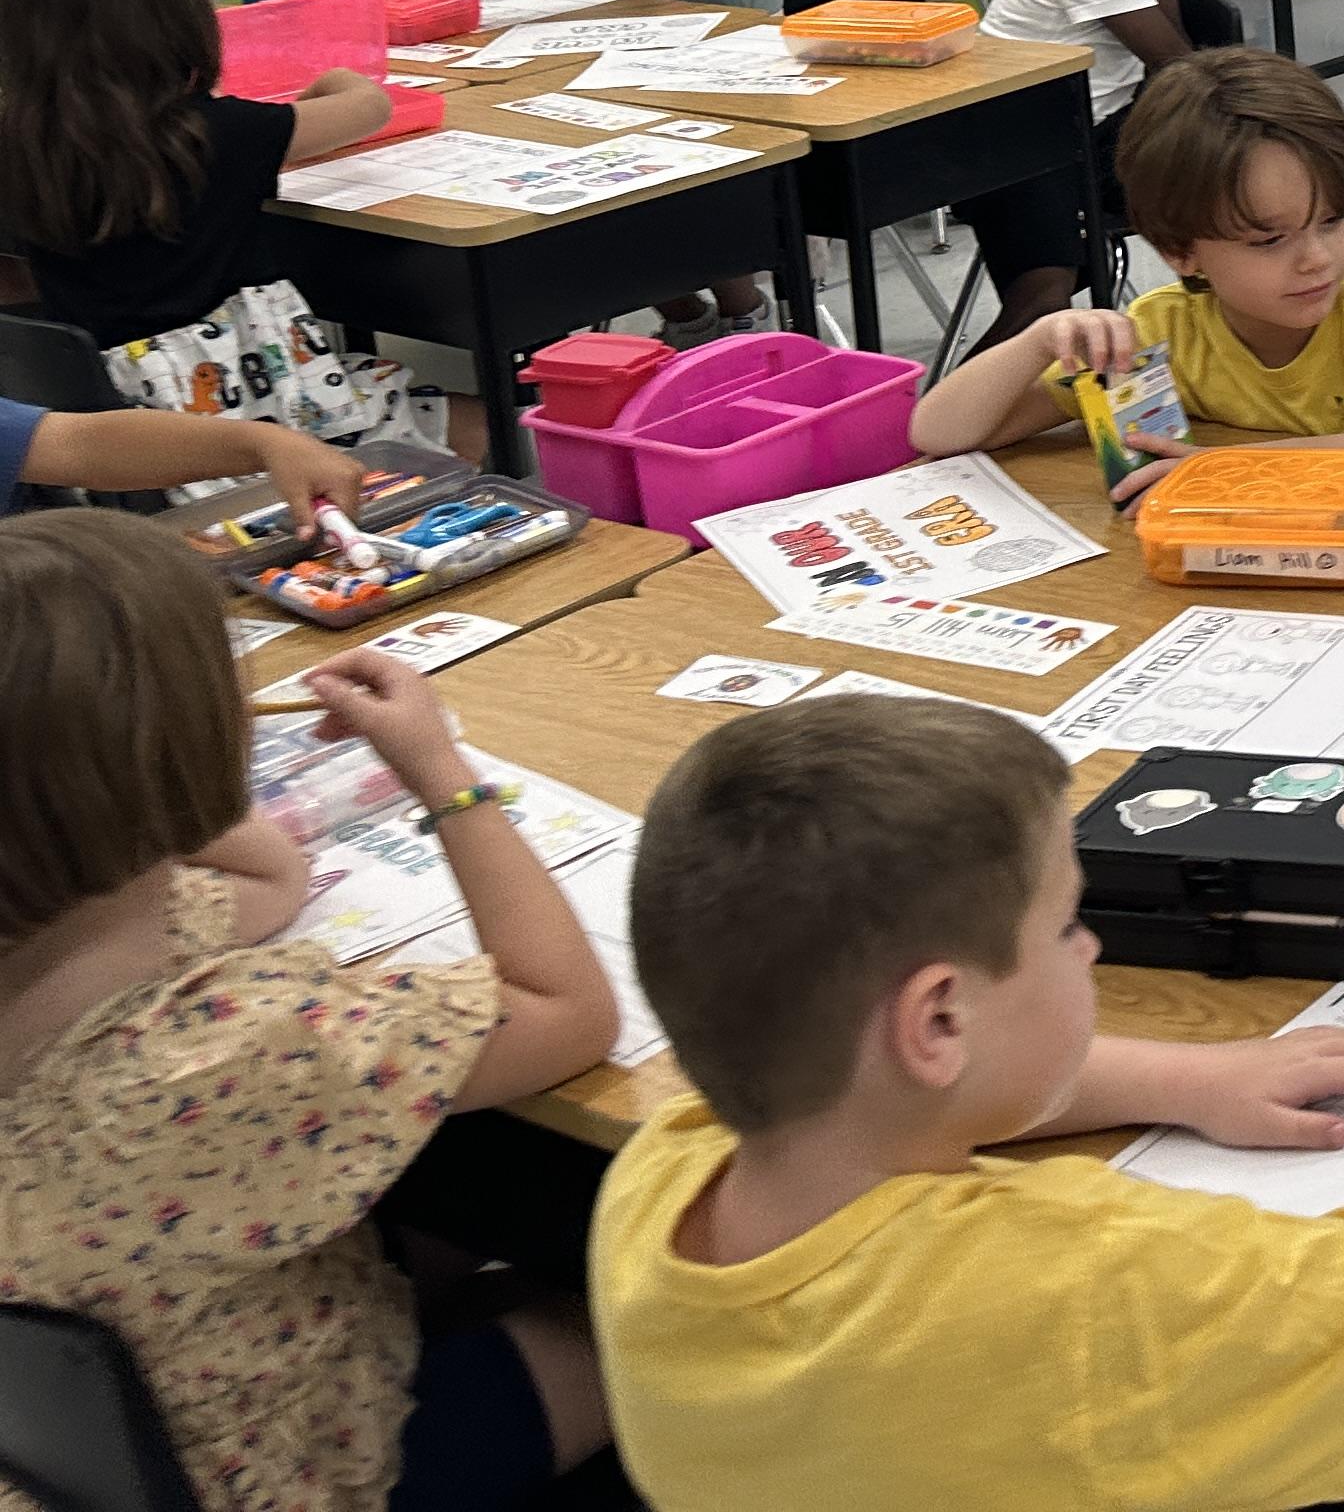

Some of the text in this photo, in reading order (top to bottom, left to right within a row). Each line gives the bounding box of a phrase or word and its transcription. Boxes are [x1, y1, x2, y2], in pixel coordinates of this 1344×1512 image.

[768, 520, 854, 568] OUR
[836, 507, 936, 576] 1ST GRADE
[903, 493, 1000, 548] ERA
[1213, 547, 1311, 571] Liam Hill
[919, 618, 963, 639] Hill
[975, 623, 1036, 650] Liam
[1057, 614, 1236, 739] FIRST DAY FEELINGS
[333, 821, 446, 878] GRADE
